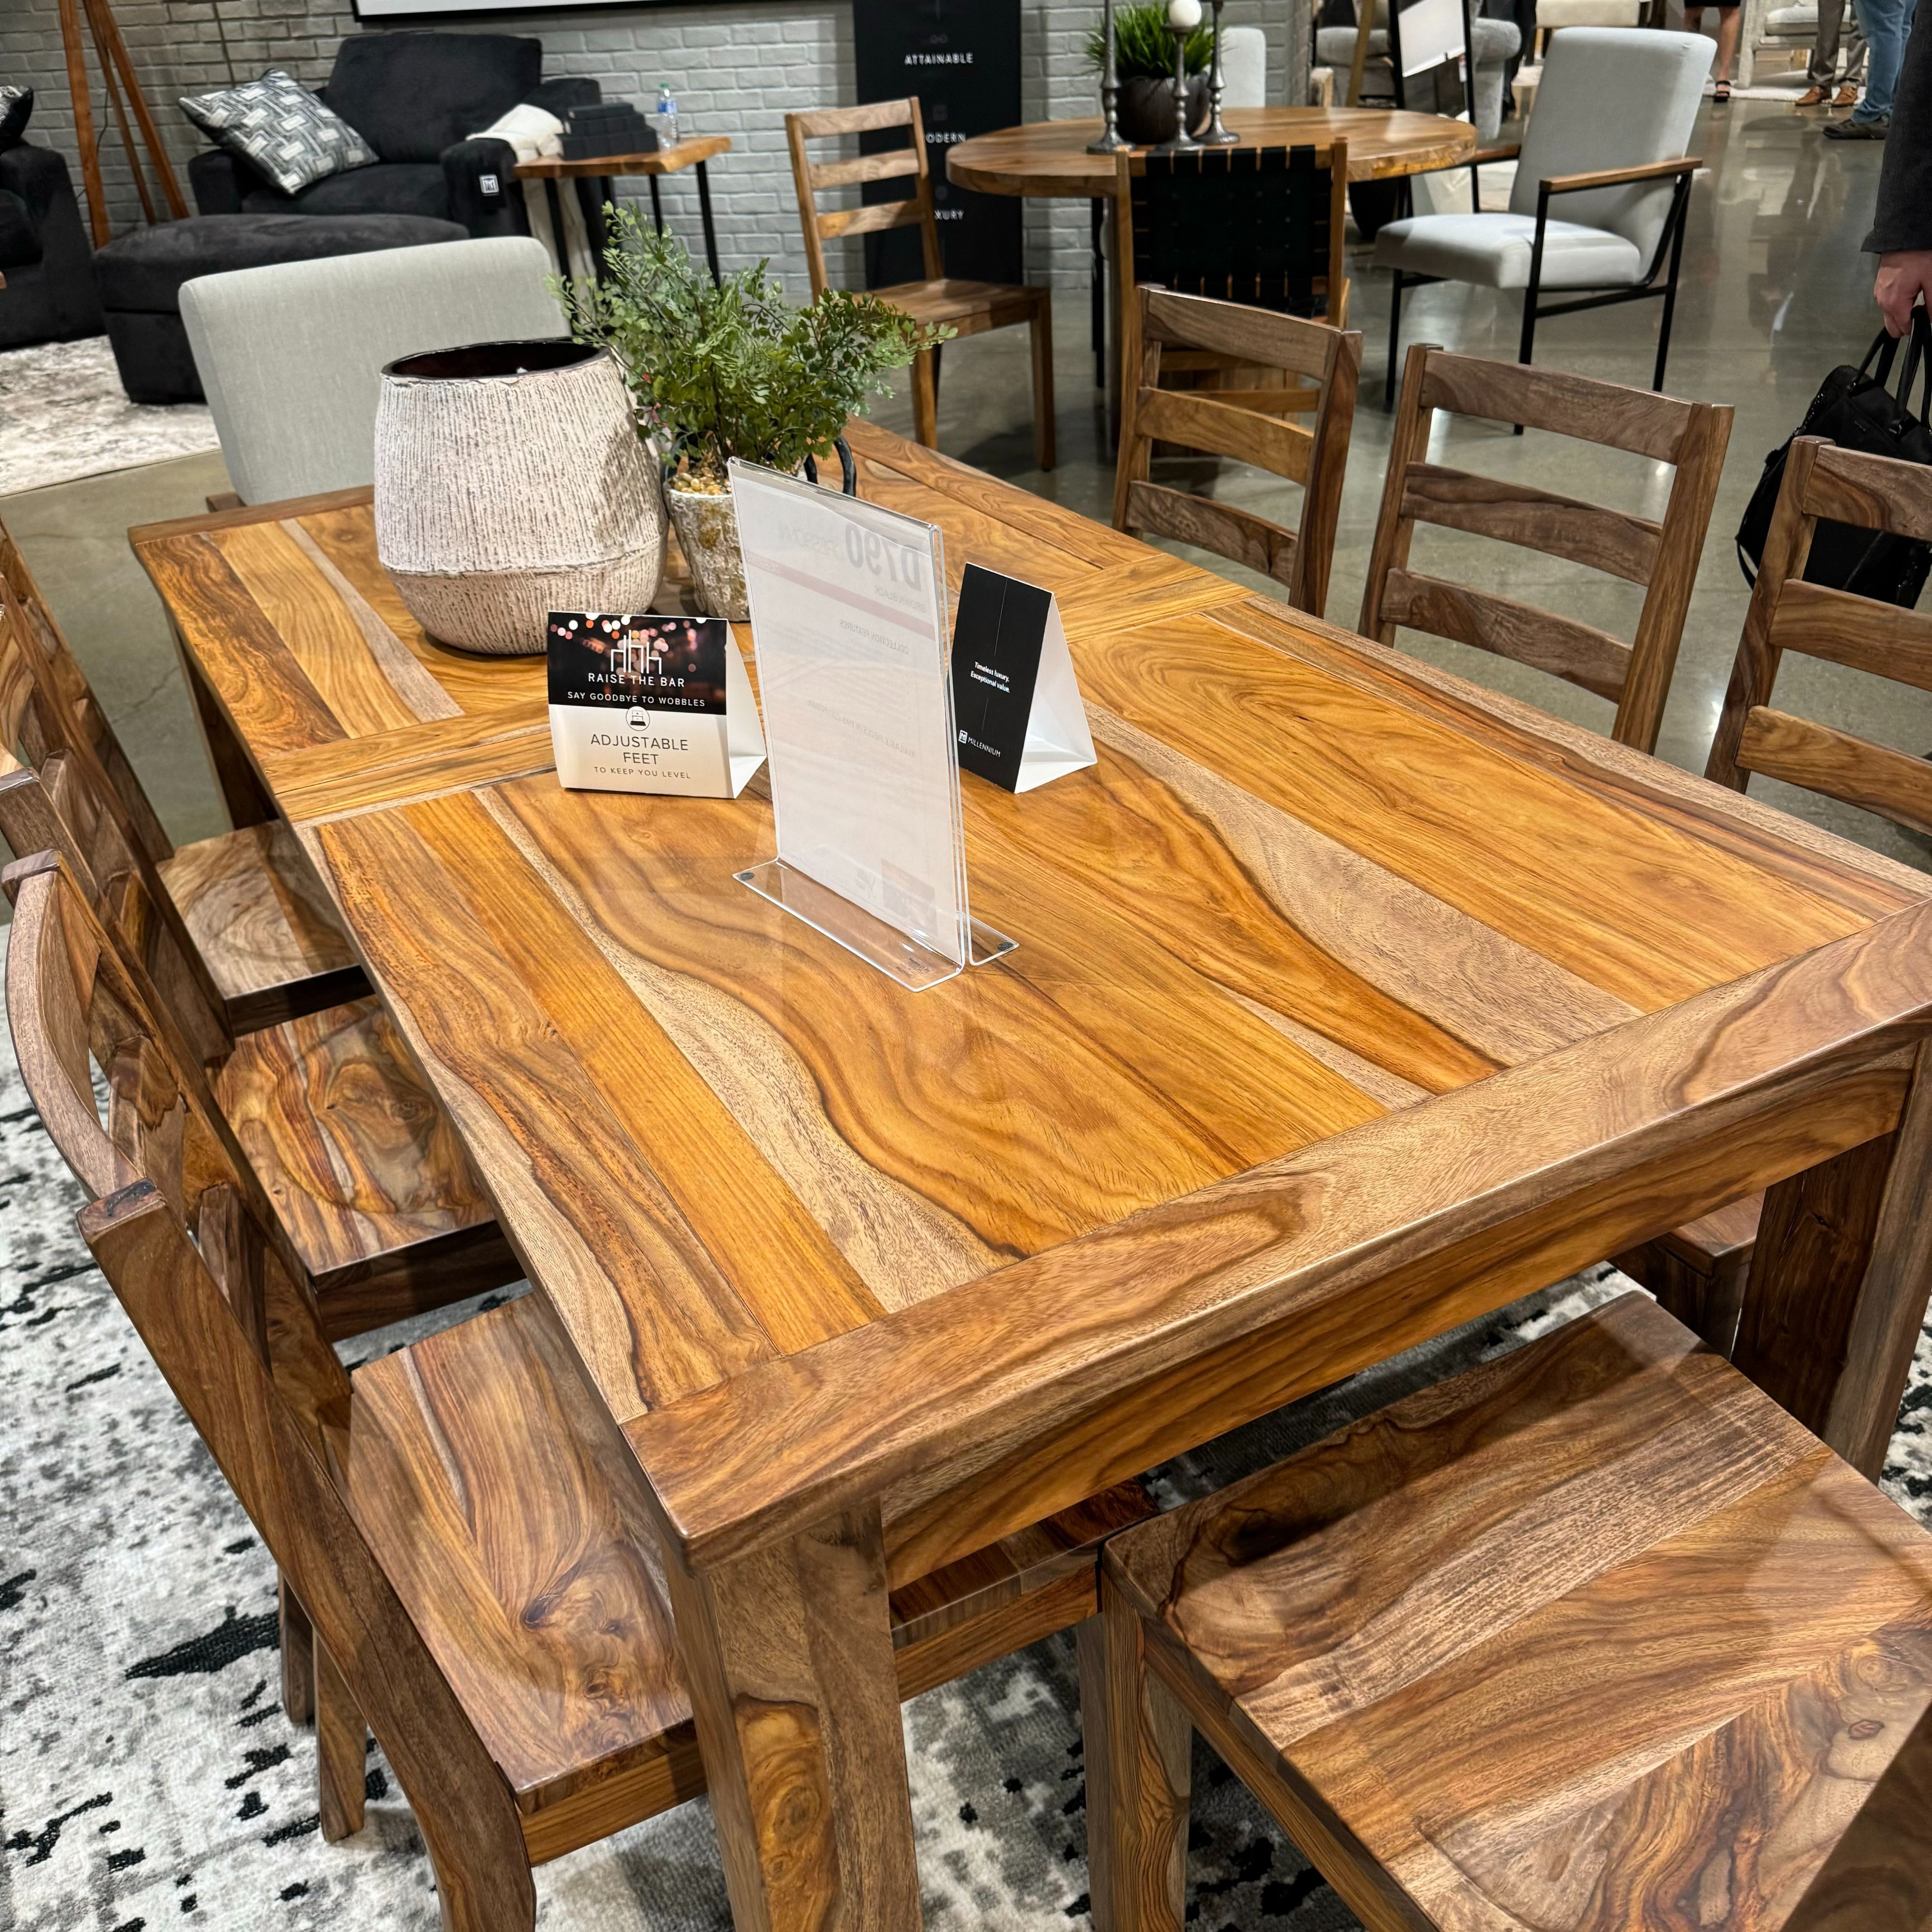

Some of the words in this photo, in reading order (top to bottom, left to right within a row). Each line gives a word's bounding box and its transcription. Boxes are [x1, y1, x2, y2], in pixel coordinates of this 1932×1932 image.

[904, 52, 974, 65] ATTAINABLE
[925, 132, 966, 143] ODERN
[934, 209, 964, 220] XURY
[588, 673, 625, 684] RAISE
[631, 675, 654, 685] THE
[660, 677, 685, 687] BAR
[590, 693, 637, 702] GOODBYE
[658, 697, 705, 706] WOBBLES
[591, 734, 689, 750] ADJUSTABLE
[968, 736, 1001, 757] MILLENNIUM
[623, 752, 658, 764] FEET
